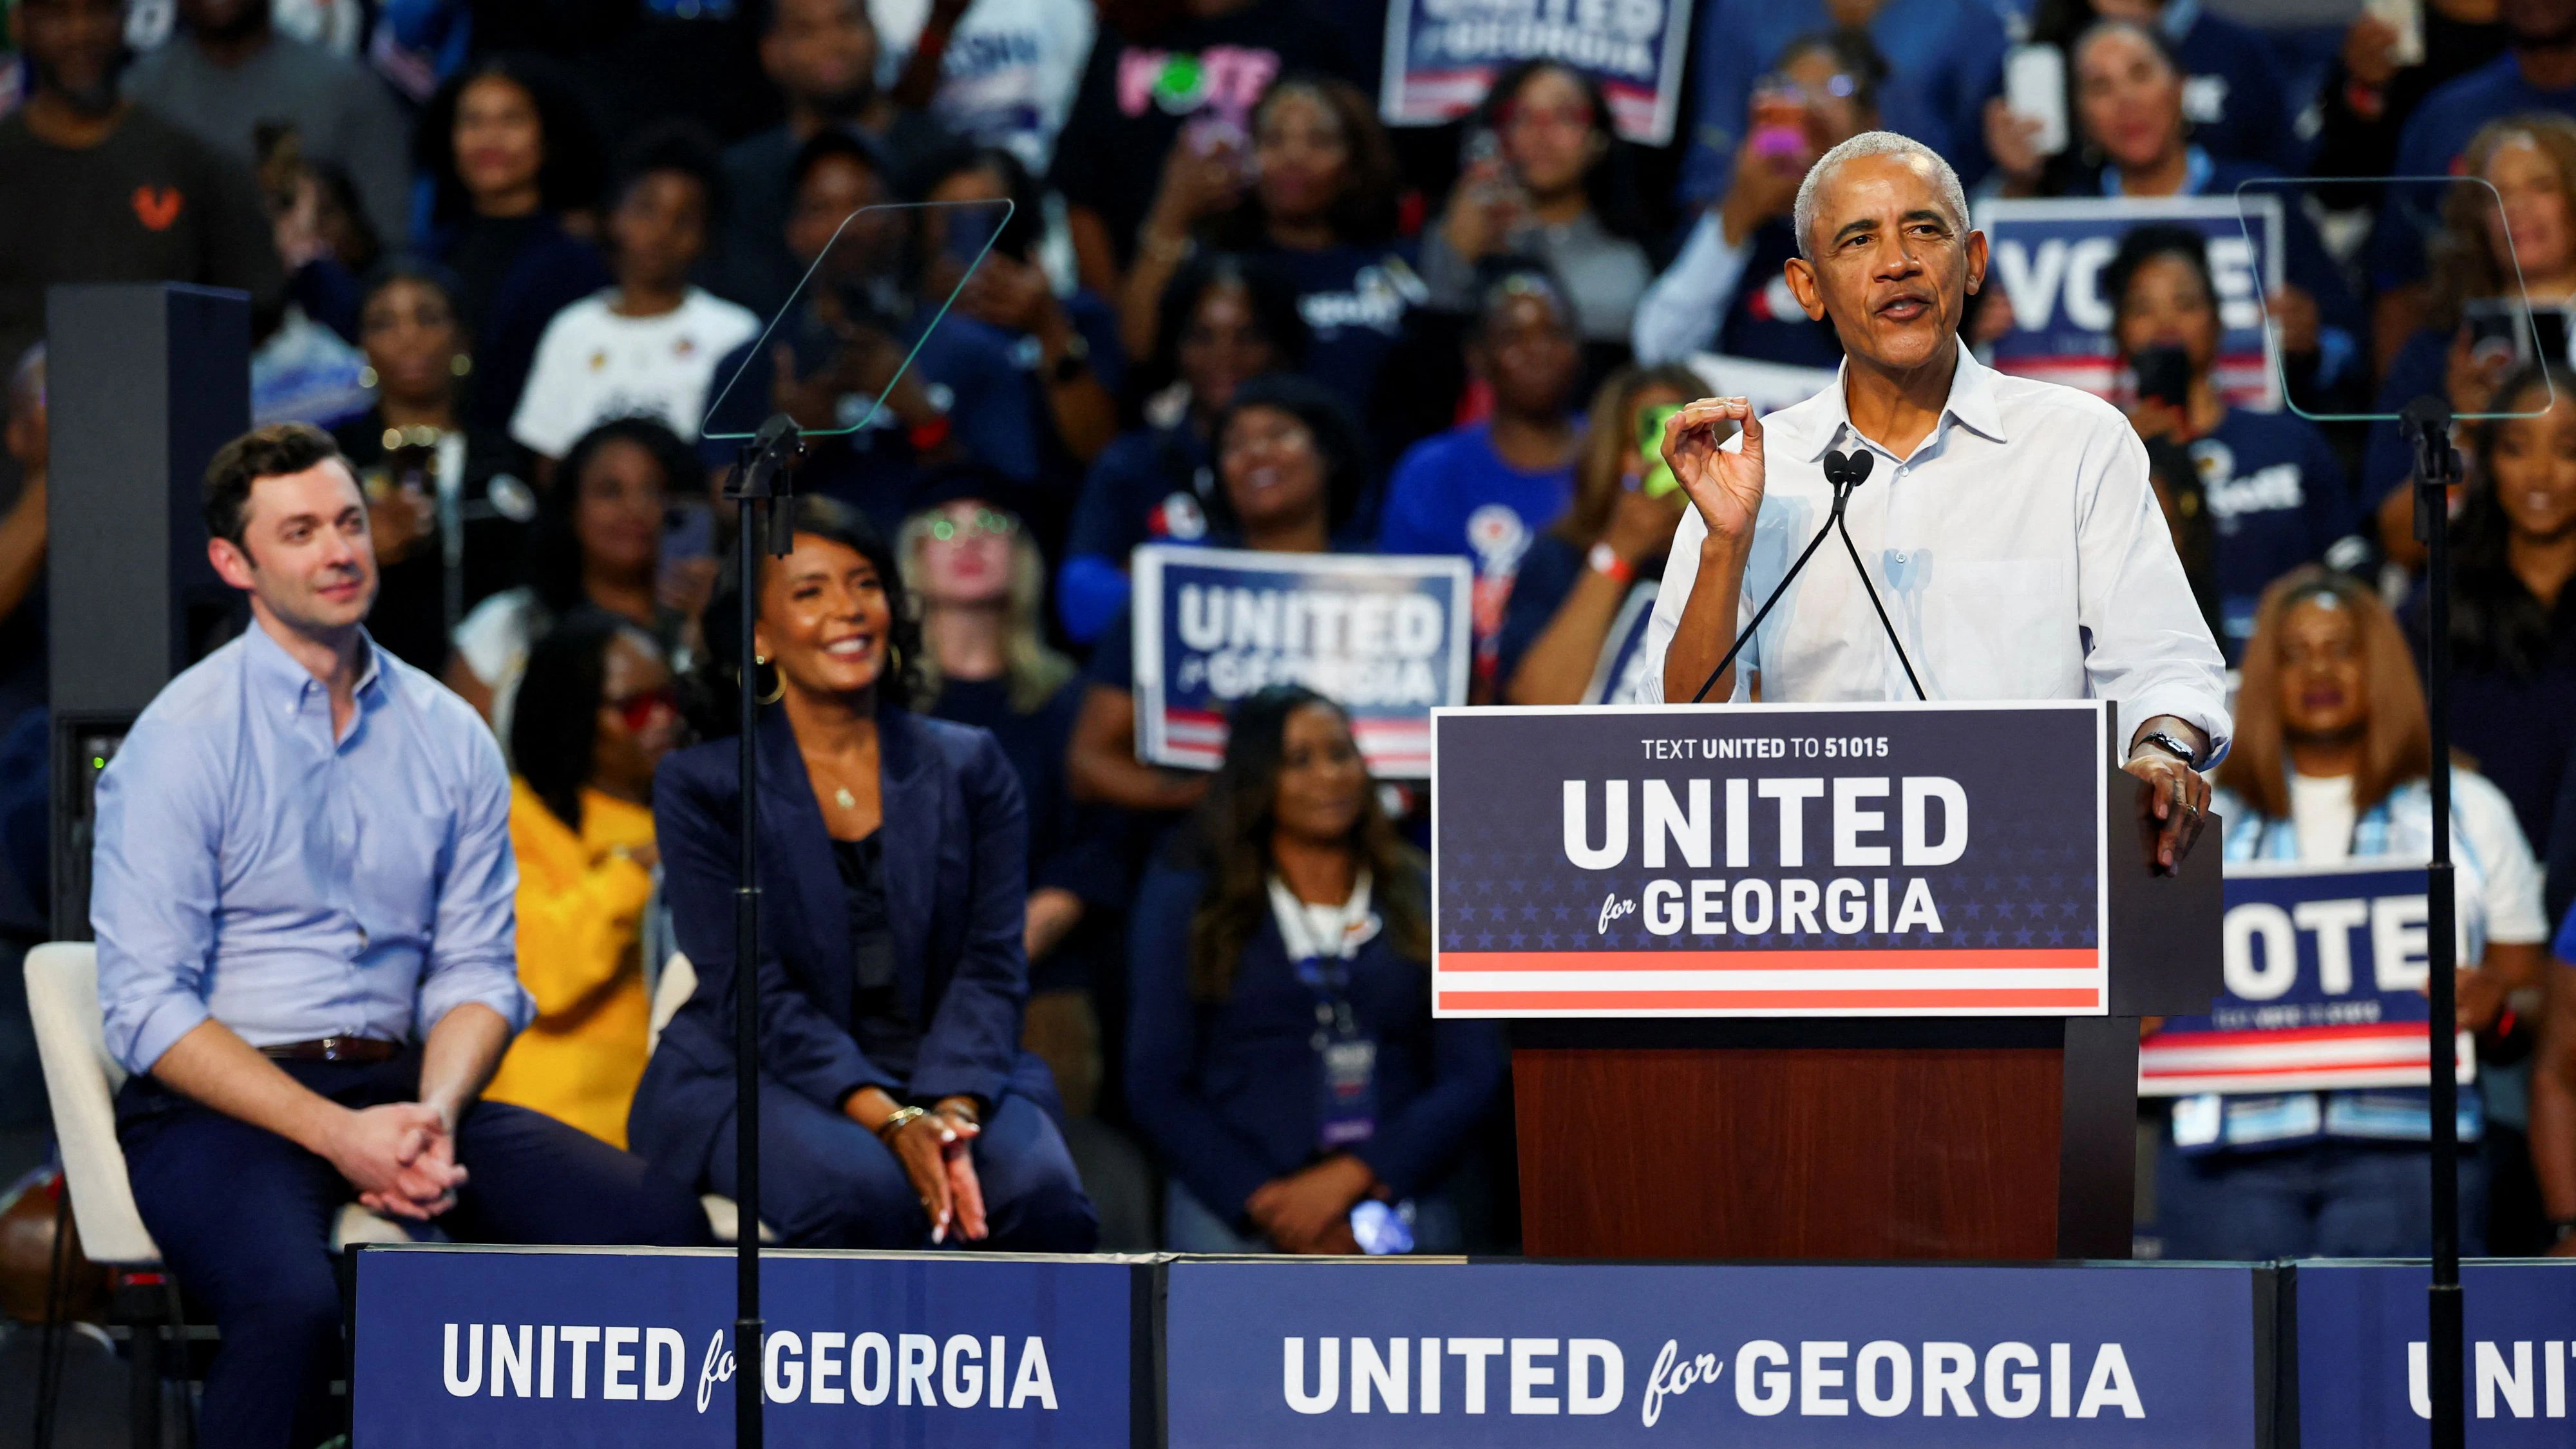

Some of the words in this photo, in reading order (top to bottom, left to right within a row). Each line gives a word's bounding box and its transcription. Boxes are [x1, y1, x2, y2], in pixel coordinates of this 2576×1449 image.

[1998, 236, 2260, 332] VOE
[1177, 582, 1444, 658] UNITED
[1640, 739, 1698, 760] TEXT
[1702, 737, 1786, 759] UNITED
[1790, 737, 1819, 758] TO
[1824, 736, 1889, 758] 51015
[1562, 775, 1969, 871] UNITED
[1597, 892, 1637, 936] for
[1642, 876, 1945, 936] GEORGIA
[2223, 893, 2429, 1002] OTE
[442, 1323, 686, 1401] UNITED
[696, 1328, 738, 1414] fo
[763, 1329, 1059, 1410] GEORGIA
[1283, 1336, 1625, 1416] UNITED
[1641, 1338, 1724, 1428] for
[1734, 1339, 2146, 1419] GEORGIA
